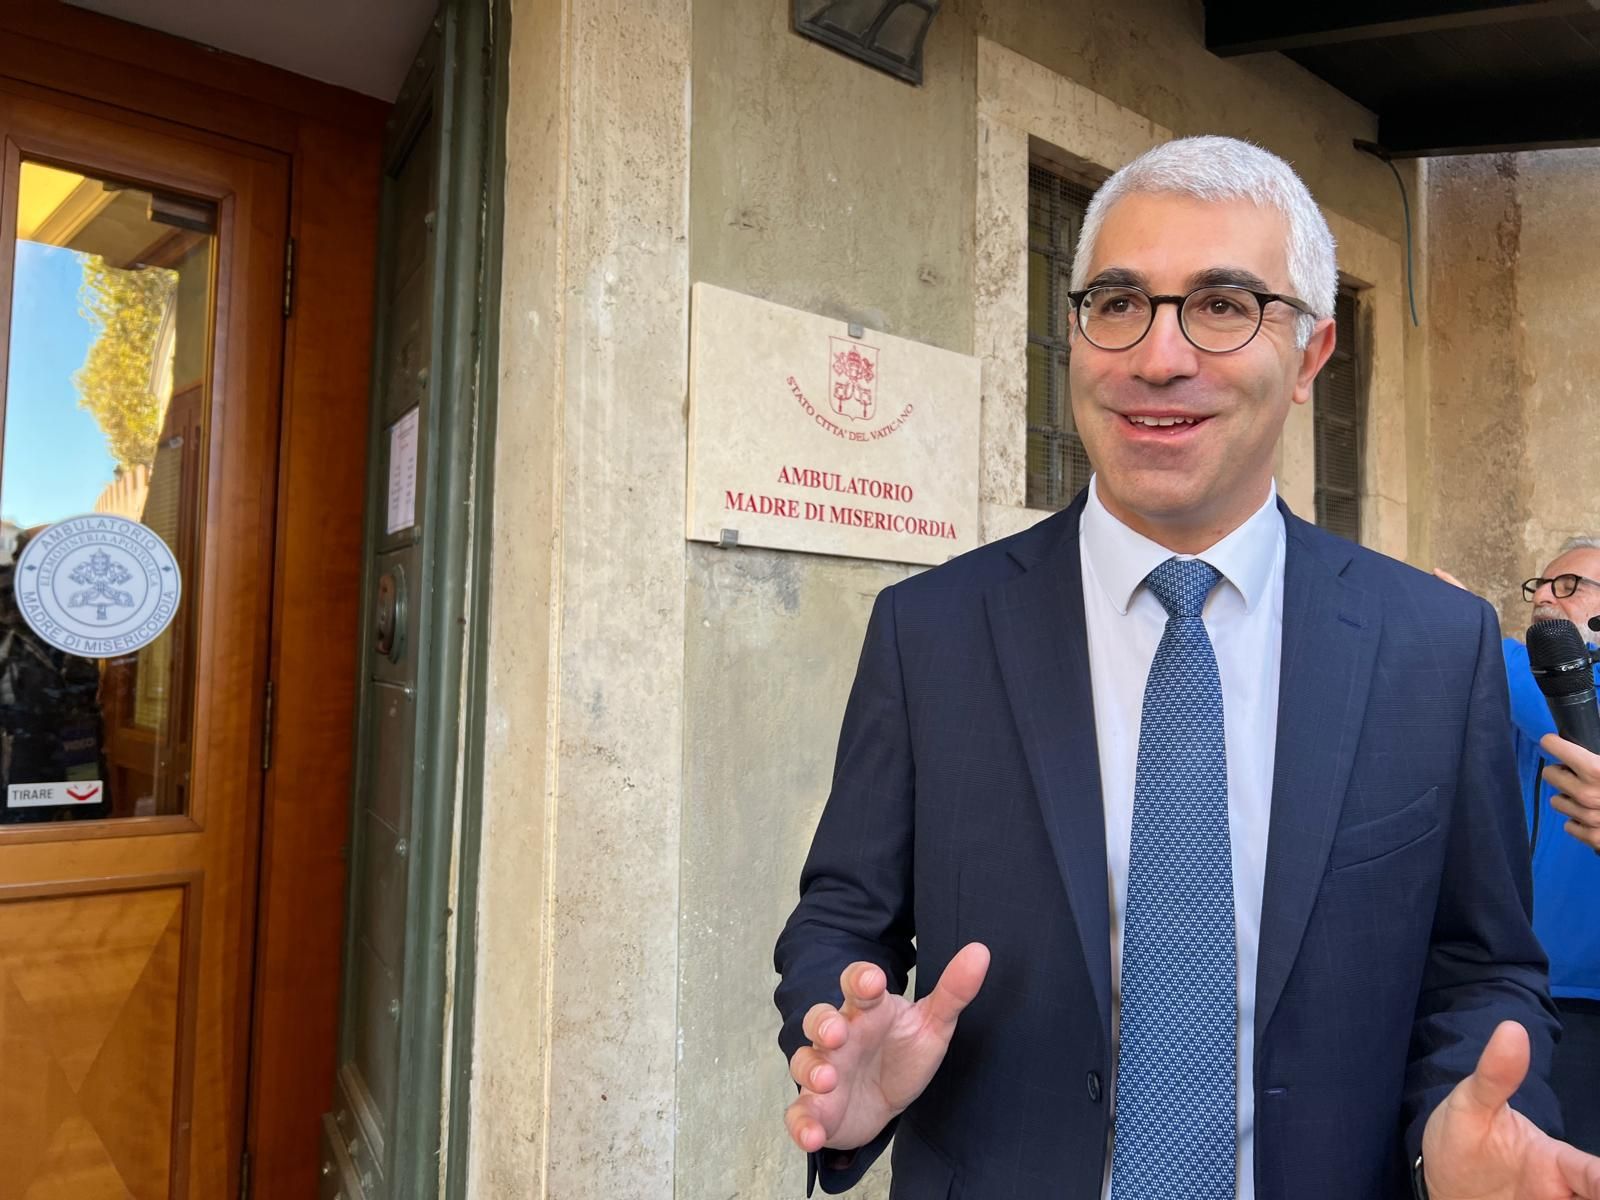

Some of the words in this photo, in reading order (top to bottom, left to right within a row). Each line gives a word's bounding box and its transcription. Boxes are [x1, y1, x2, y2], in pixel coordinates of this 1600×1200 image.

[787, 376, 815, 416] STATO
[848, 431, 869, 441] DEL
[870, 403, 914, 440] VATICANO
[777, 465, 913, 503] AMBULATORIO
[40, 519, 157, 550] AMBULATORIO
[725, 490, 800, 518] MADRE
[805, 502, 824, 522] DI
[829, 505, 957, 539] MISERICORDIA
[111, 534, 159, 588] APOSTOLICA
[22, 591, 62, 640] MADRE
[63, 634, 81, 648] DI
[84, 590, 175, 651] MISERICORDIA
[12, 788, 55, 801] TIRARE
